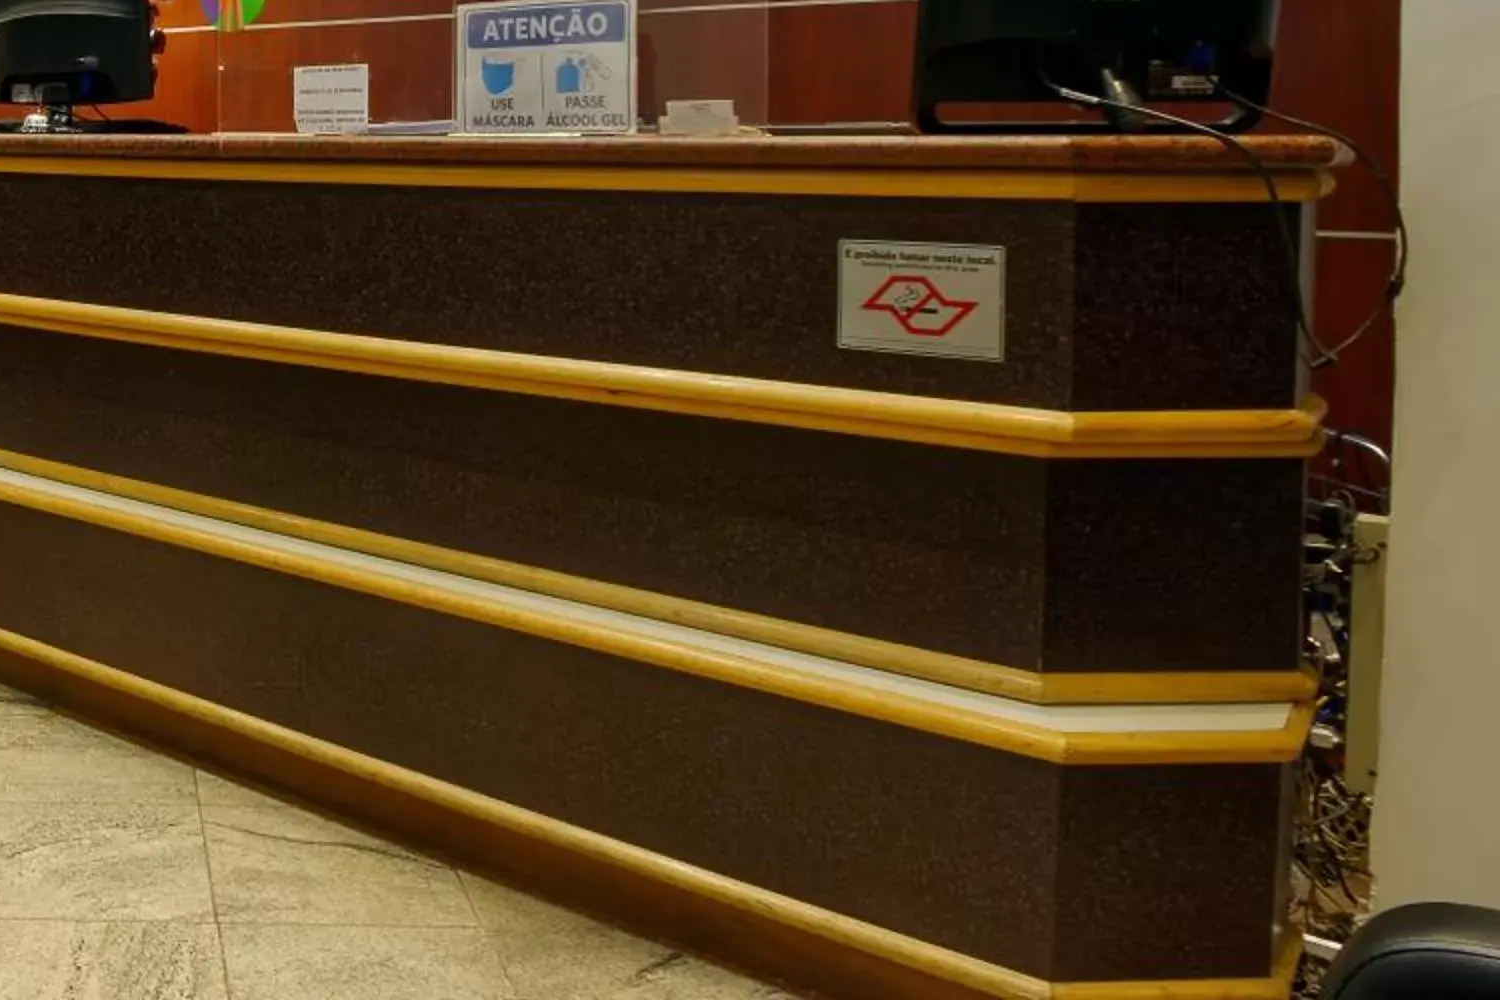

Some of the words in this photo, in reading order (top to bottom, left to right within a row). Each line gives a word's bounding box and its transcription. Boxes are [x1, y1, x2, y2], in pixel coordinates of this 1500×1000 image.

[483, 8, 608, 43] ATENÇÃO
[491, 98, 514, 110] USE
[565, 96, 605, 109] PASSE
[473, 113, 535, 128] MÁSCARA
[546, 111, 597, 127] ÁLCOOL
[601, 113, 626, 126] GEL
